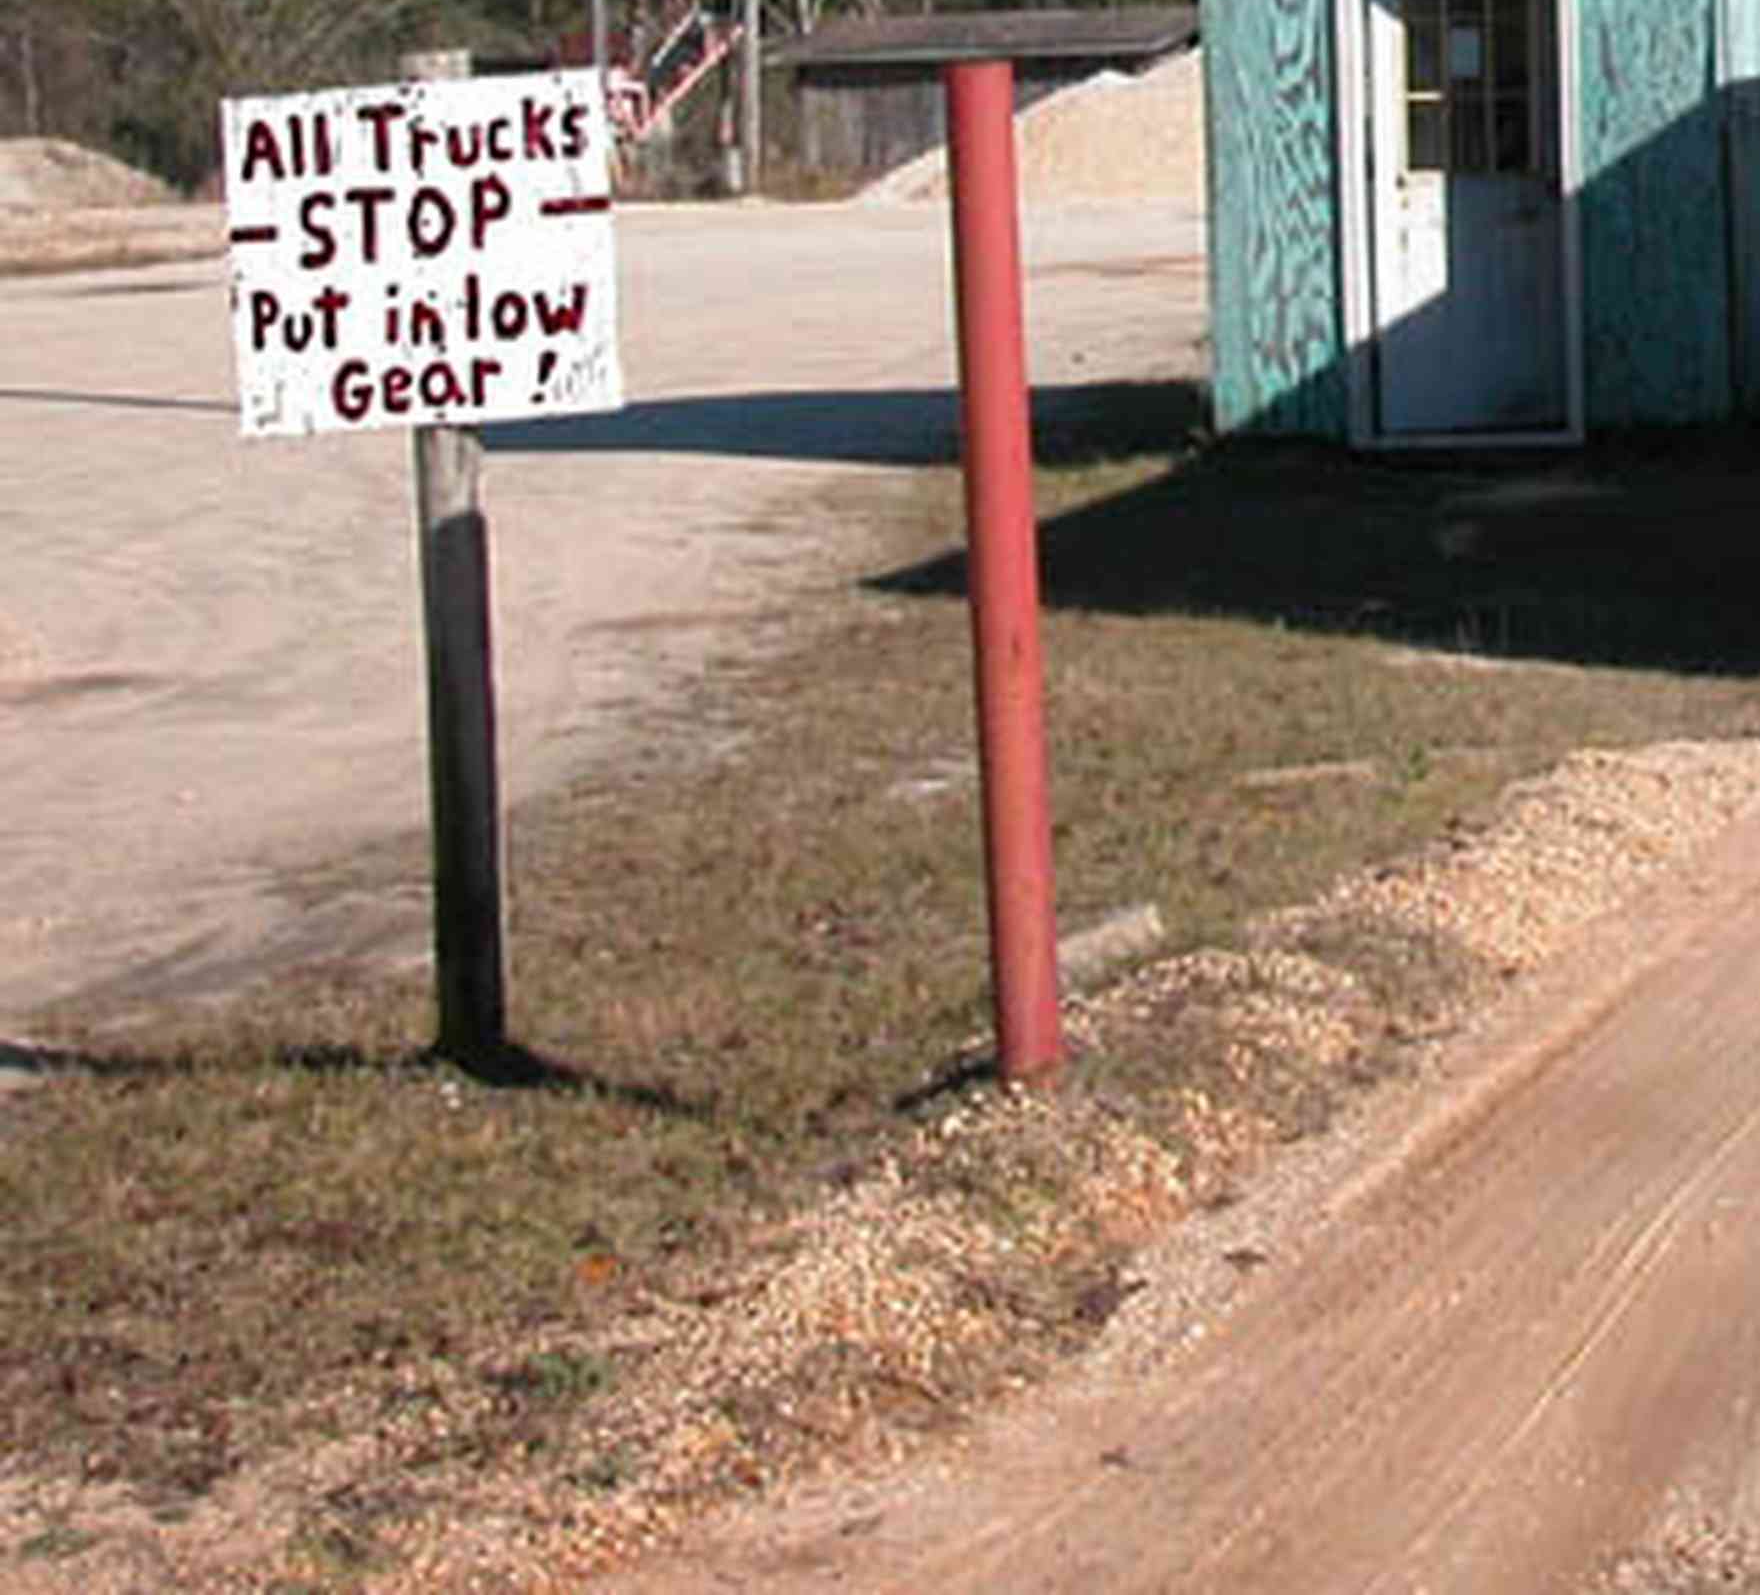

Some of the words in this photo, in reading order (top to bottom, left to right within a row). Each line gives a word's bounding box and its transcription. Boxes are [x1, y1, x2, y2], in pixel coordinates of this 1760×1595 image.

[241, 113, 332, 181] All
[357, 98, 588, 172] Trucks
[249, 287, 350, 352] Put
[386, 283, 447, 345] in
[464, 273, 588, 341] low
